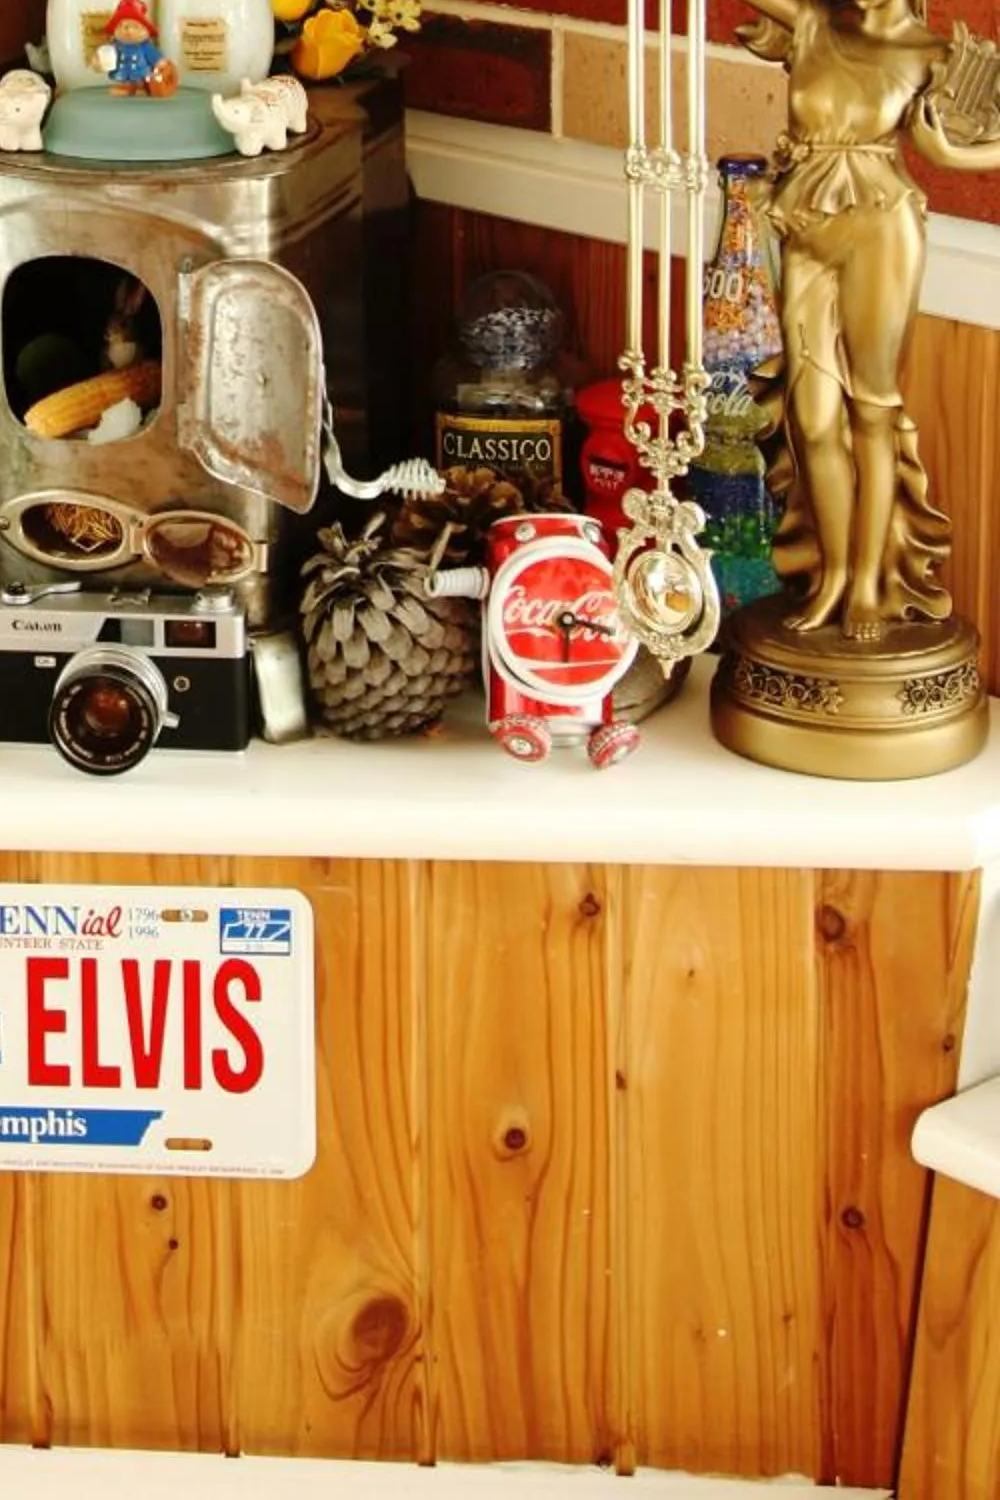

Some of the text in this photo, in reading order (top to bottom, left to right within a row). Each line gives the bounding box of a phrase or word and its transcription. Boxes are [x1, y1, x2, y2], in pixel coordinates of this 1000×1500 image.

[443, 432, 551, 461] CLASSICO
[11, 619, 62, 633] Canon
[58, 938, 104, 951] STATE
[26, 956, 265, 1094] ELVIS
